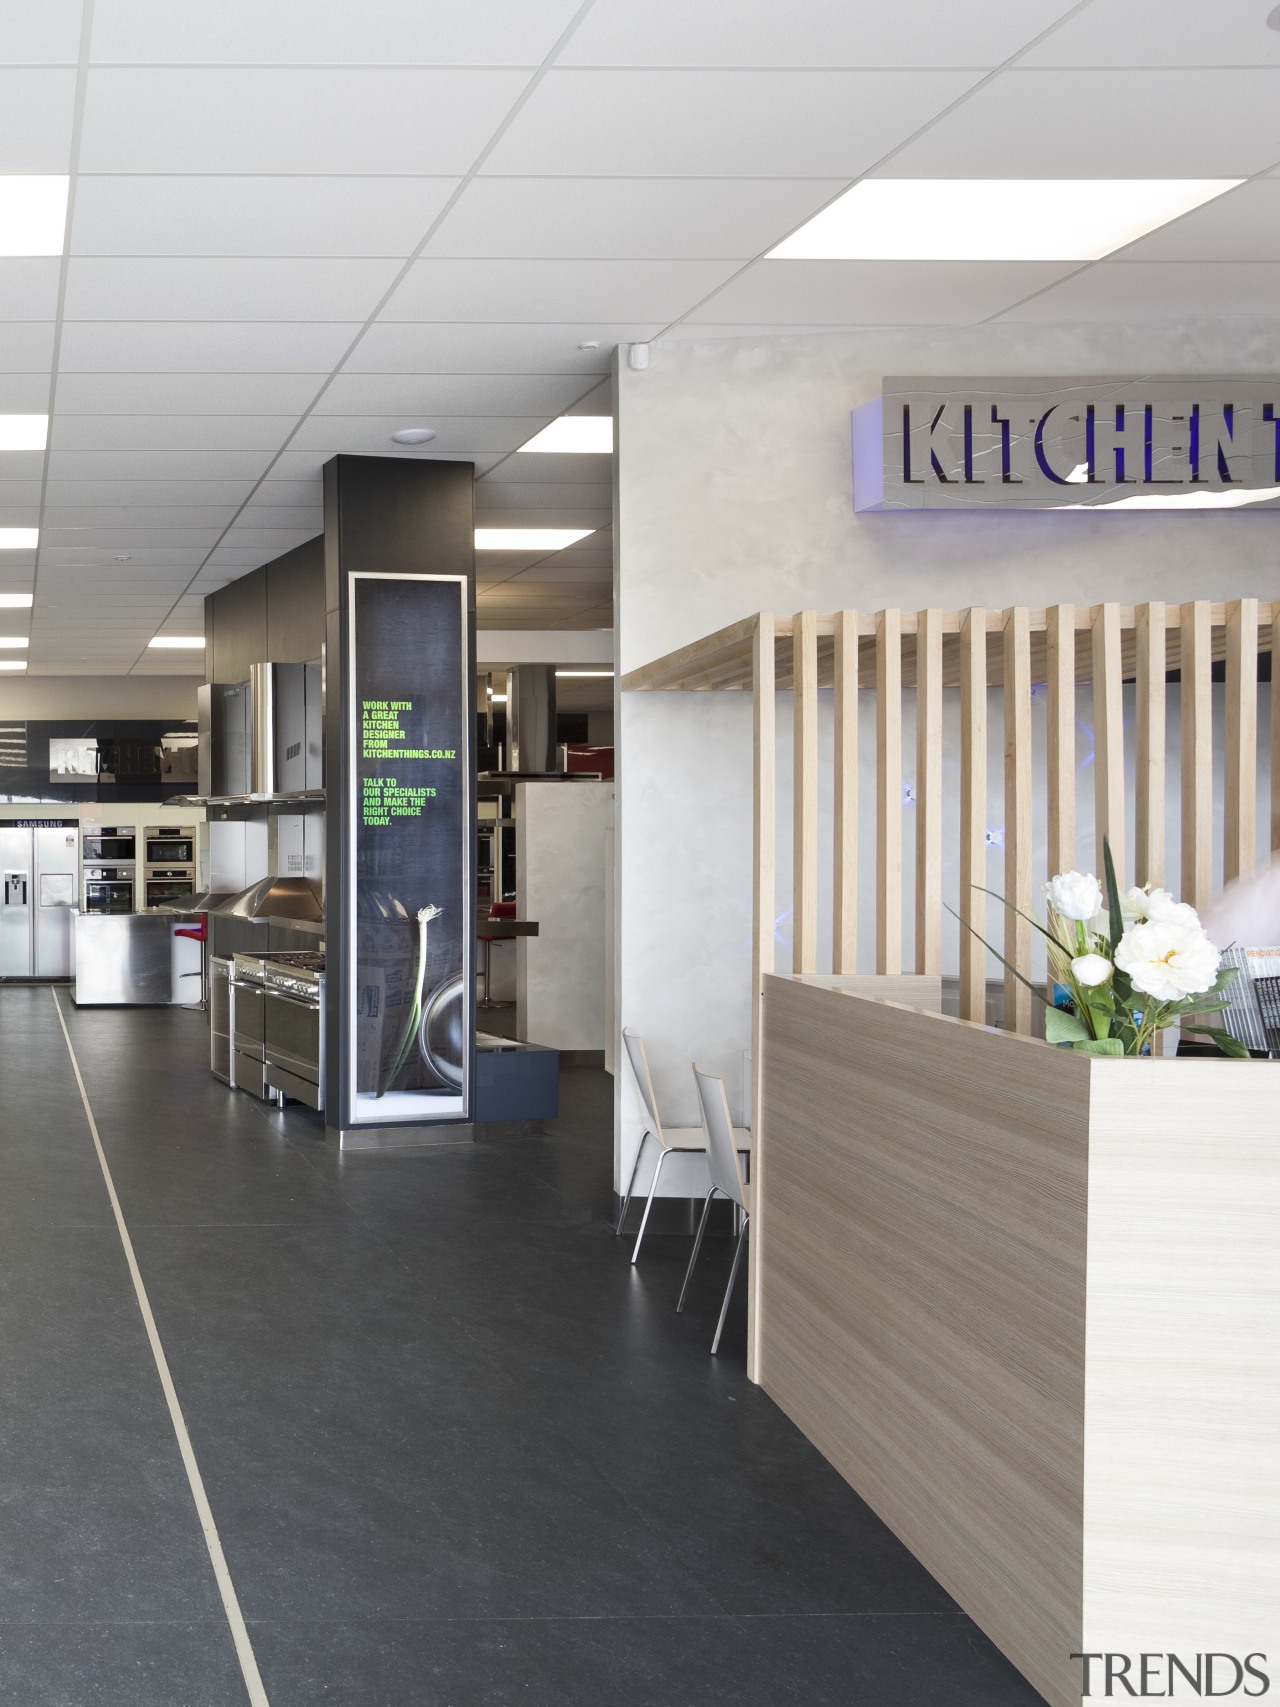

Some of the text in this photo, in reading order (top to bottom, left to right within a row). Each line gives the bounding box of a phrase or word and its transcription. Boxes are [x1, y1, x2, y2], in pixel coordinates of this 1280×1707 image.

[362, 701, 412, 711] WORK WITH
[362, 711, 399, 720] A GREAT
[362, 720, 400, 730] KITCHEN
[363, 730, 406, 739] DESIGNER
[363, 740, 388, 749] FROM
[363, 749, 456, 759] KITCHENTHINGS.CO.NZ
[363, 778, 397, 787] TALK TO
[363, 788, 437, 797] OUR SPECIALISTS
[363, 797, 426, 807] AND MAKE THE
[363, 807, 421, 816] RIGHT CHOICE
[16, 820, 63, 828] SAMSUNG
[363, 816, 392, 826] TODAY.
